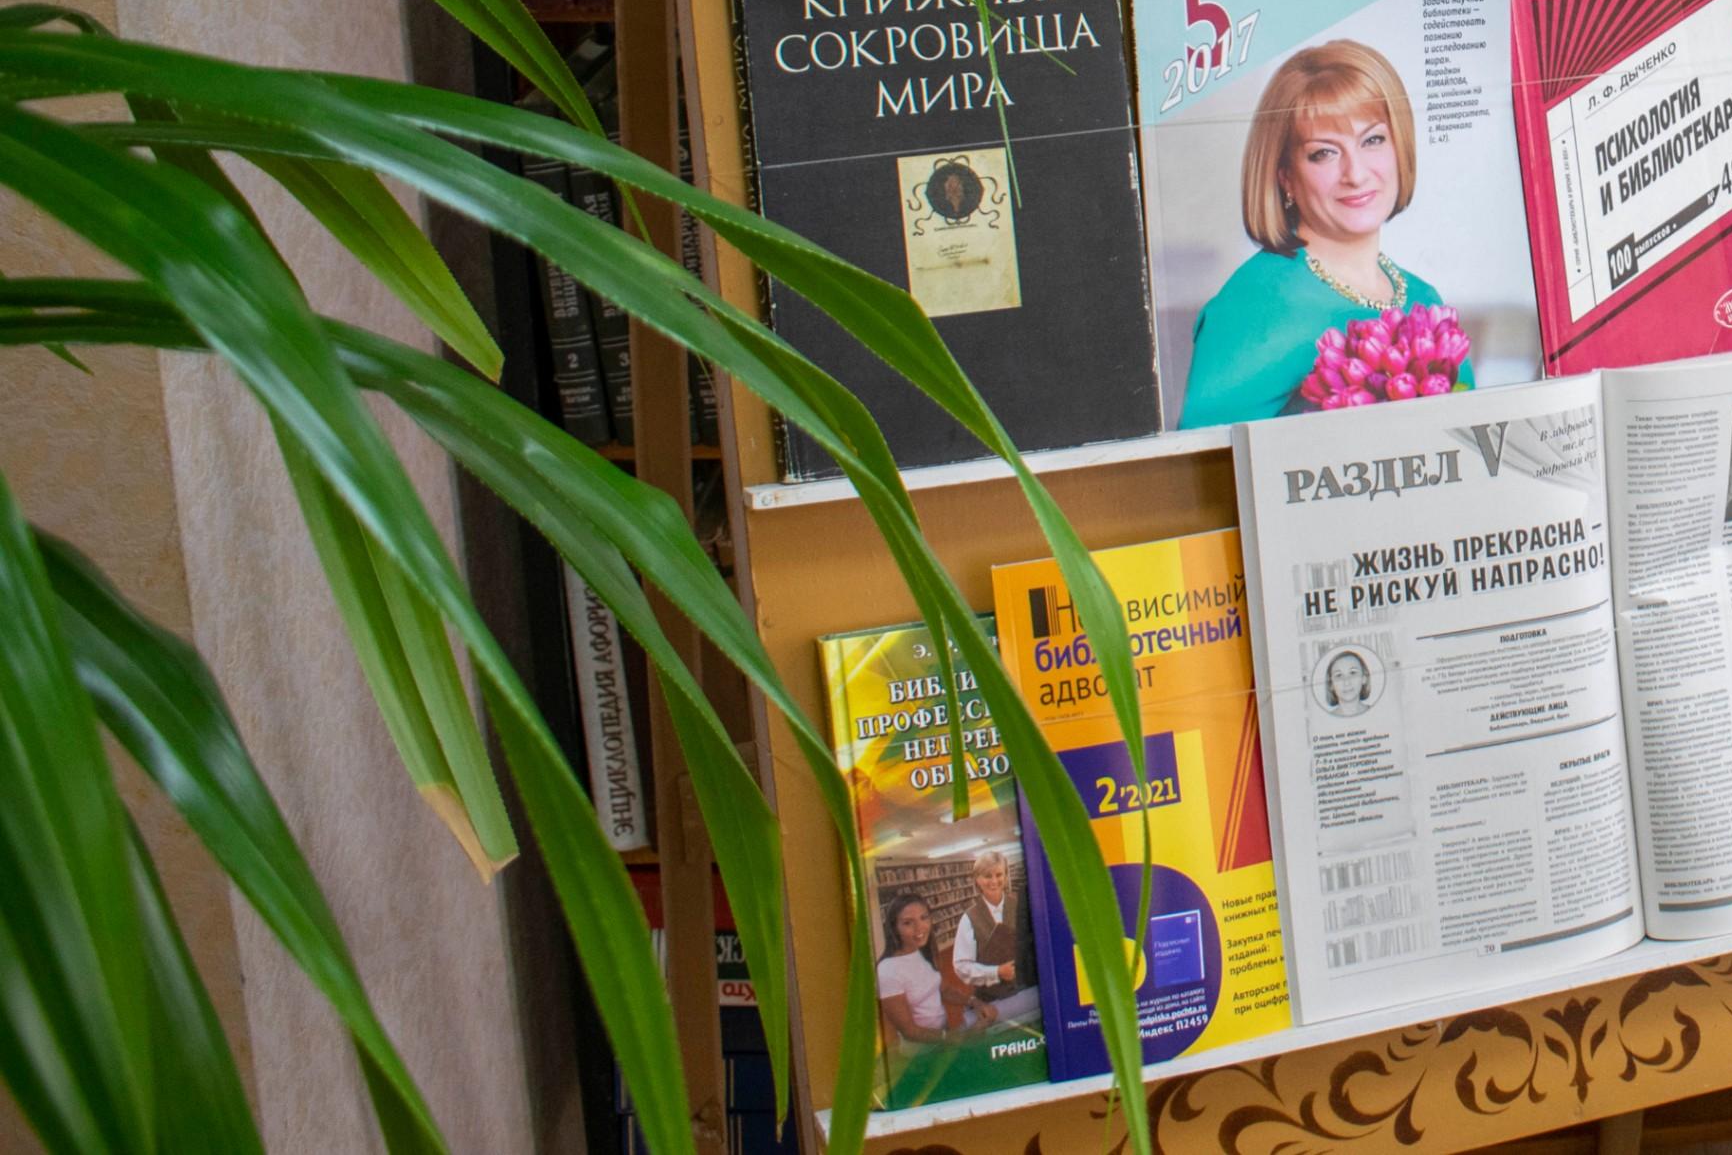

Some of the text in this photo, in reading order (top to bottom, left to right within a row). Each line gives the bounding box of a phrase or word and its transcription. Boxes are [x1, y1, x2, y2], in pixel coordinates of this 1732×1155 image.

[1423, 18, 1486, 30] содействовать
[774, 13, 1102, 74] СОКРОВИЩА
[1159, 9, 1261, 114] 2017
[1619, 41, 1678, 90] ДЫЧЕНКО
[875, 71, 1015, 119] МИРА
[1594, 77, 1702, 176] ПСИХОЛОГИЯ
[1599, 185, 1614, 216] И
[1609, 242, 1635, 283] 100
[567, 353, 580, 369] 2
[1284, 449, 1462, 505] РАЗДЕЛ
[1352, 517, 1586, 578] ЖИЗНЬ ПРЕКРАСНА
[1304, 542, 1606, 617] НЕ РИСКУЙ НАПРАСНО!
[1035, 608, 1242, 673] биботечный
[1499, 628, 1548, 644] ПОДГОТОВКА
[1039, 666, 1156, 707] адвот
[596, 670, 635, 838] ЭНЦИКЛОПЕДИЯ
[1222, 894, 1253, 910] Новые
[1224, 905, 1266, 923] книжных
[1226, 932, 1264, 950] Закупка
[1228, 945, 1271, 962] изданий:
[1230, 957, 1278, 976] проблемы
[1233, 981, 1281, 1002] Авторское
[1234, 1002, 1253, 1016] при
[1176, 1014, 1209, 1032] П2459
